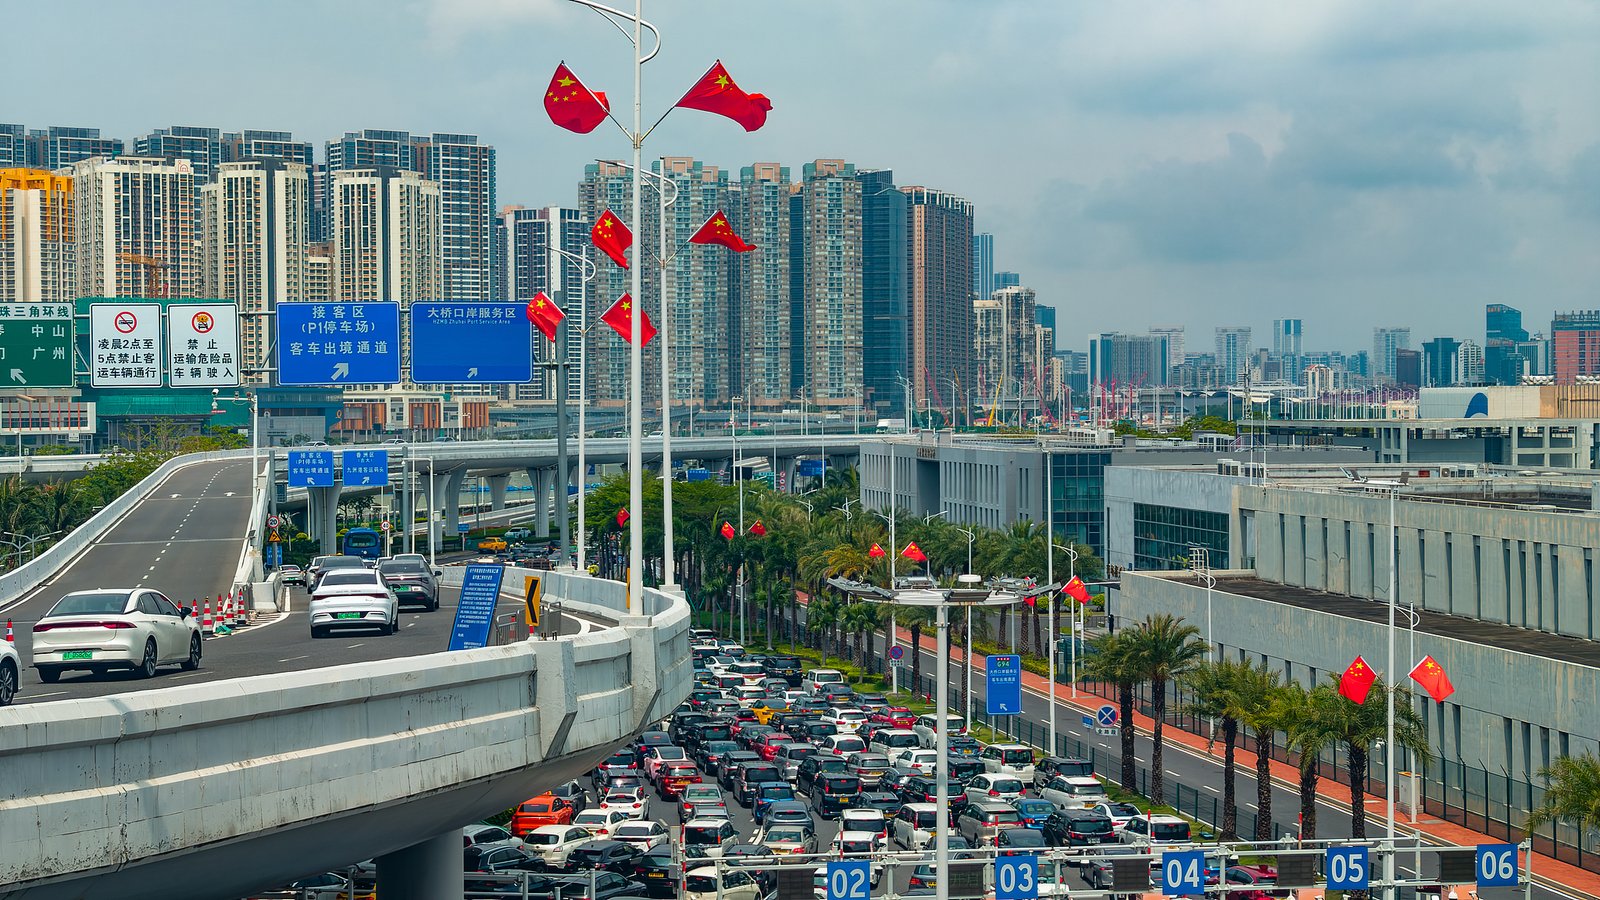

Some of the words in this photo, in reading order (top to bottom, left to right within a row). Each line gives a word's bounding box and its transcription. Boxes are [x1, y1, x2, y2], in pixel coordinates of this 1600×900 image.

[0, 305, 69, 318] 珠三角环线
[312, 305, 364, 319] 接客区
[427, 307, 516, 319] 大桥口岸服务区
[31, 324, 65, 338] 中山
[98, 338, 154, 350] 凌晨2点至
[187, 338, 218, 350] 禁止
[290, 340, 388, 356] 客车出境通道
[32, 347, 65, 360] 广州
[98, 353, 155, 364] 5点禁止客
[173, 353, 232, 364] 运输危险品
[97, 367, 157, 379] 运车辆通行
[174, 367, 234, 379] 车辆驶入
[1331, 853, 1364, 883] 05
[1481, 850, 1513, 880] 06
[1000, 863, 1033, 893] 03
[1167, 858, 1200, 888] 04
[832, 868, 866, 899] 02
